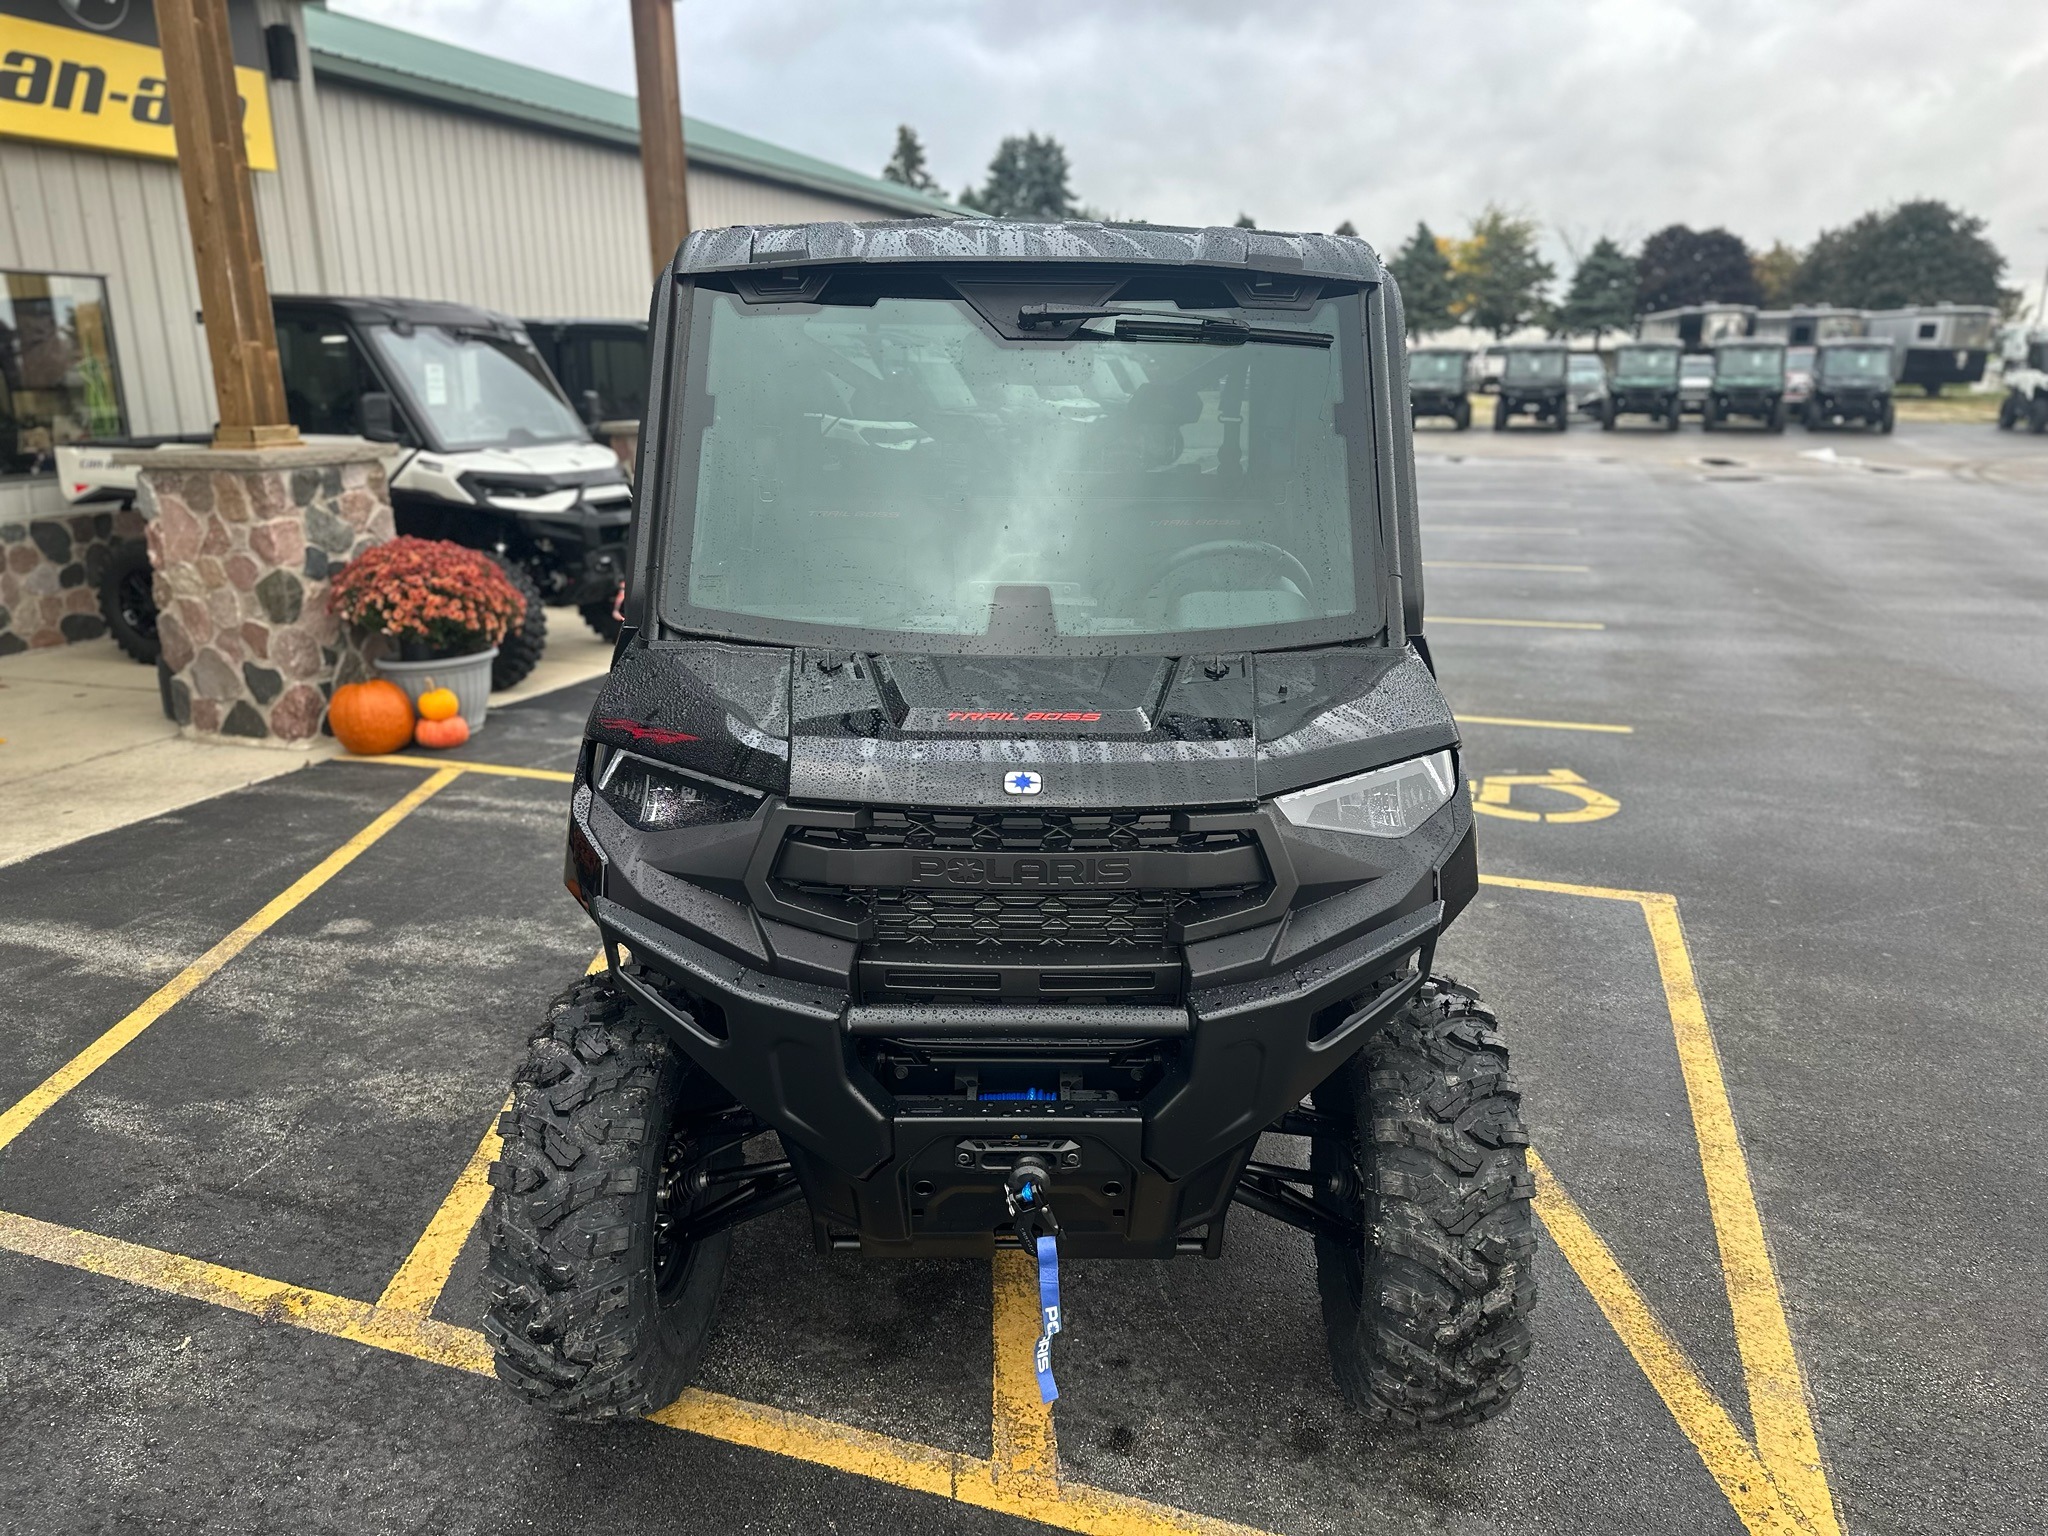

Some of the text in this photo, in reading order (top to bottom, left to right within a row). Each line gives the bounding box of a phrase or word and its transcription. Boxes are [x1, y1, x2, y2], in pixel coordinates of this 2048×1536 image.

[0, 50, 247, 127] an-a
[947, 711, 1102, 722] TRAIL BOSS
[911, 855, 1132, 885] POLARIS
